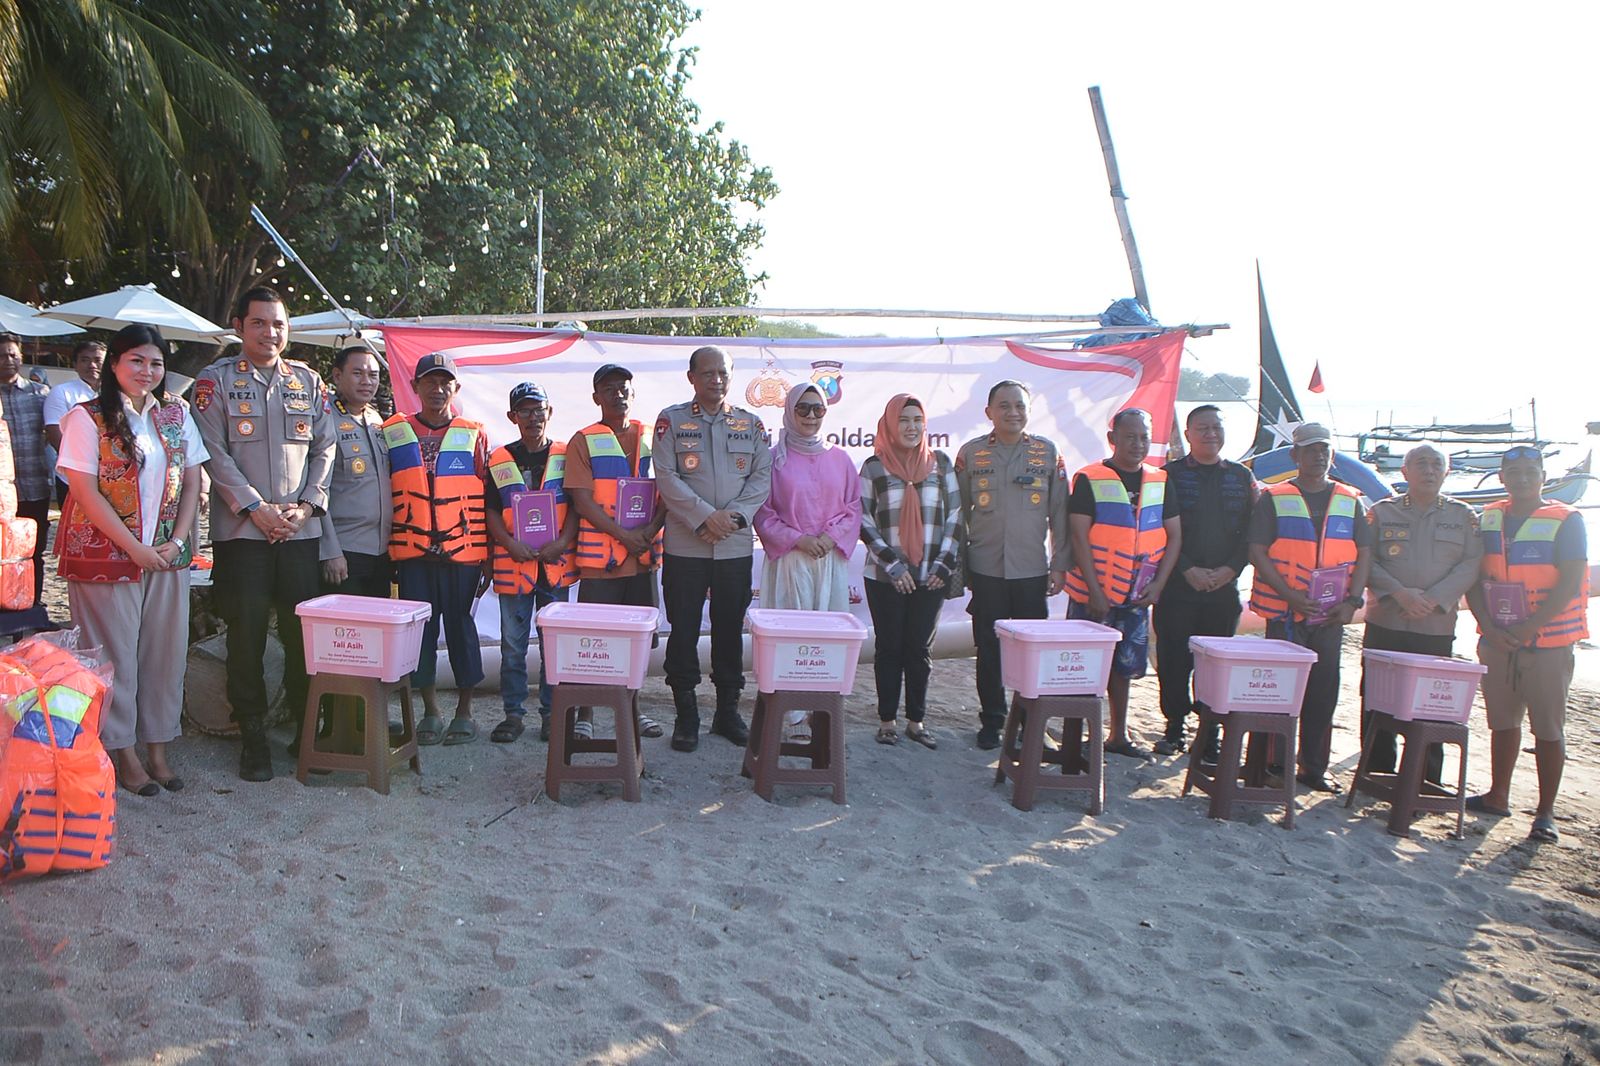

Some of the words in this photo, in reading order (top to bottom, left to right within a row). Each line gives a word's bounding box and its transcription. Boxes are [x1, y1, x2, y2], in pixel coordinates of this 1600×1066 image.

[229, 392, 256, 400] REZI
[283, 392, 311, 401] POLRI
[826, 427, 876, 447] olda
[347, 642, 363, 650] Asih
[578, 651, 591, 659] Tali
[592, 652, 610, 660] Asih
